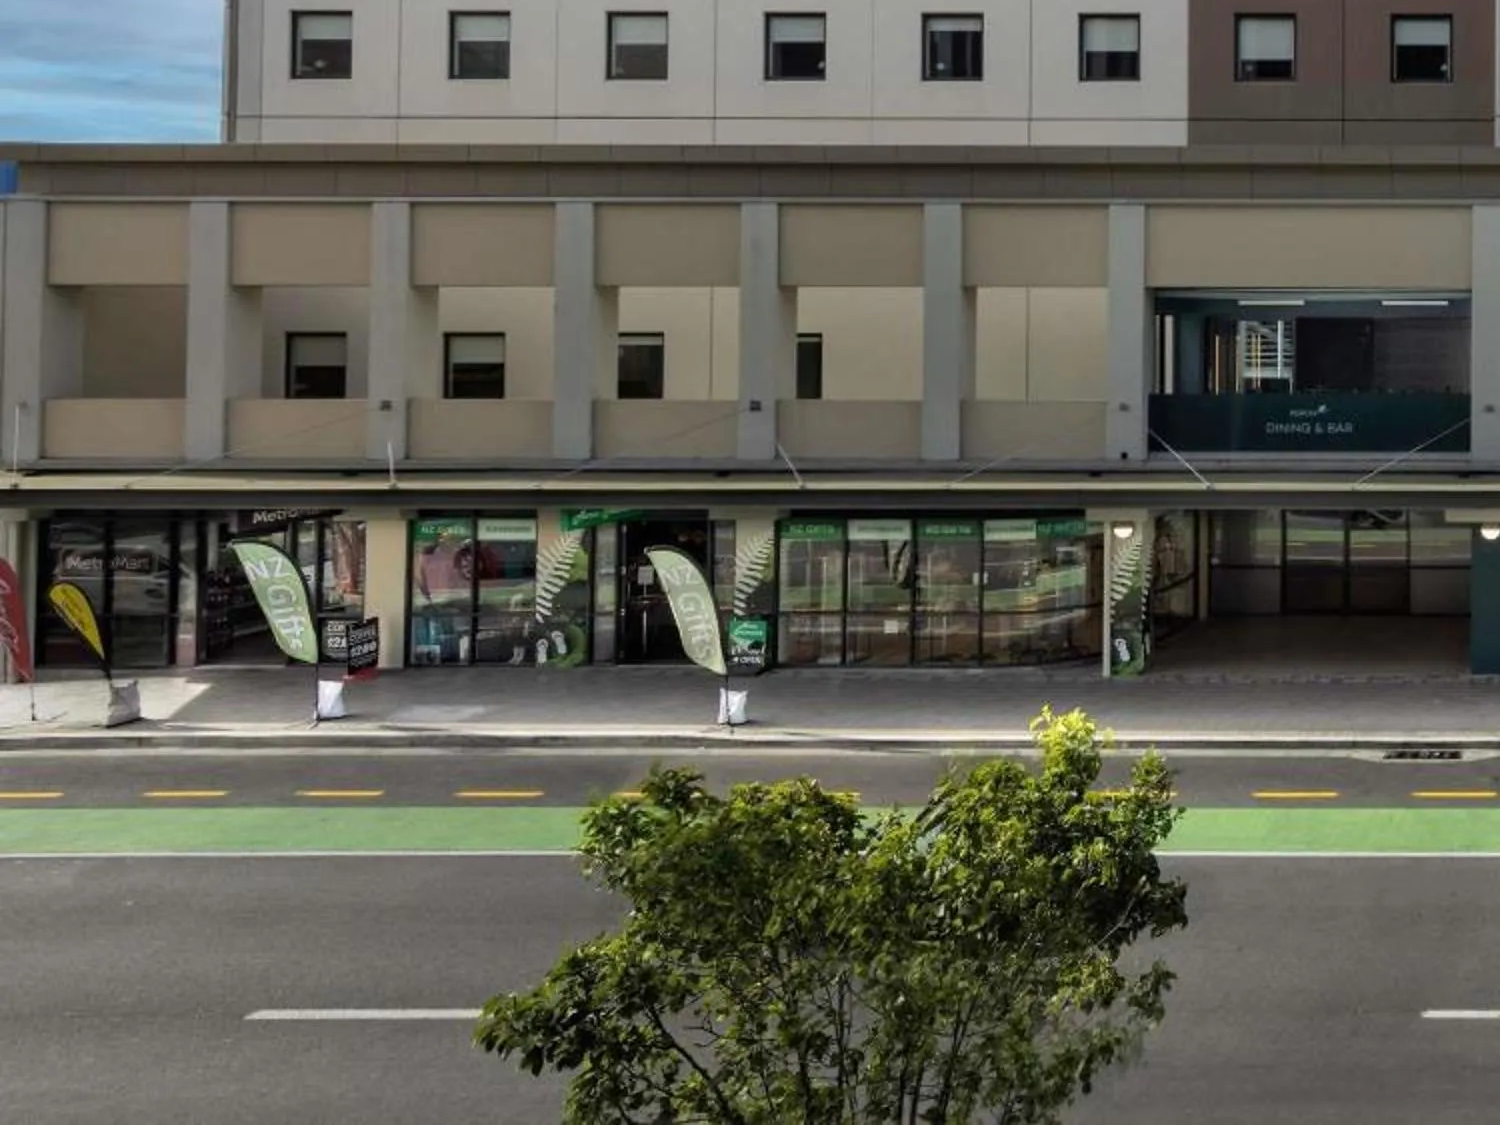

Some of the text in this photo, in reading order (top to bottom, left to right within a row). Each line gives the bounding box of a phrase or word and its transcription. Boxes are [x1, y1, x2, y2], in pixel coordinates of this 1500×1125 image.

[1265, 421, 1353, 434] DINING & BAR
[659, 564, 701, 591] NZ
[243, 557, 305, 649] NZ Gifts
